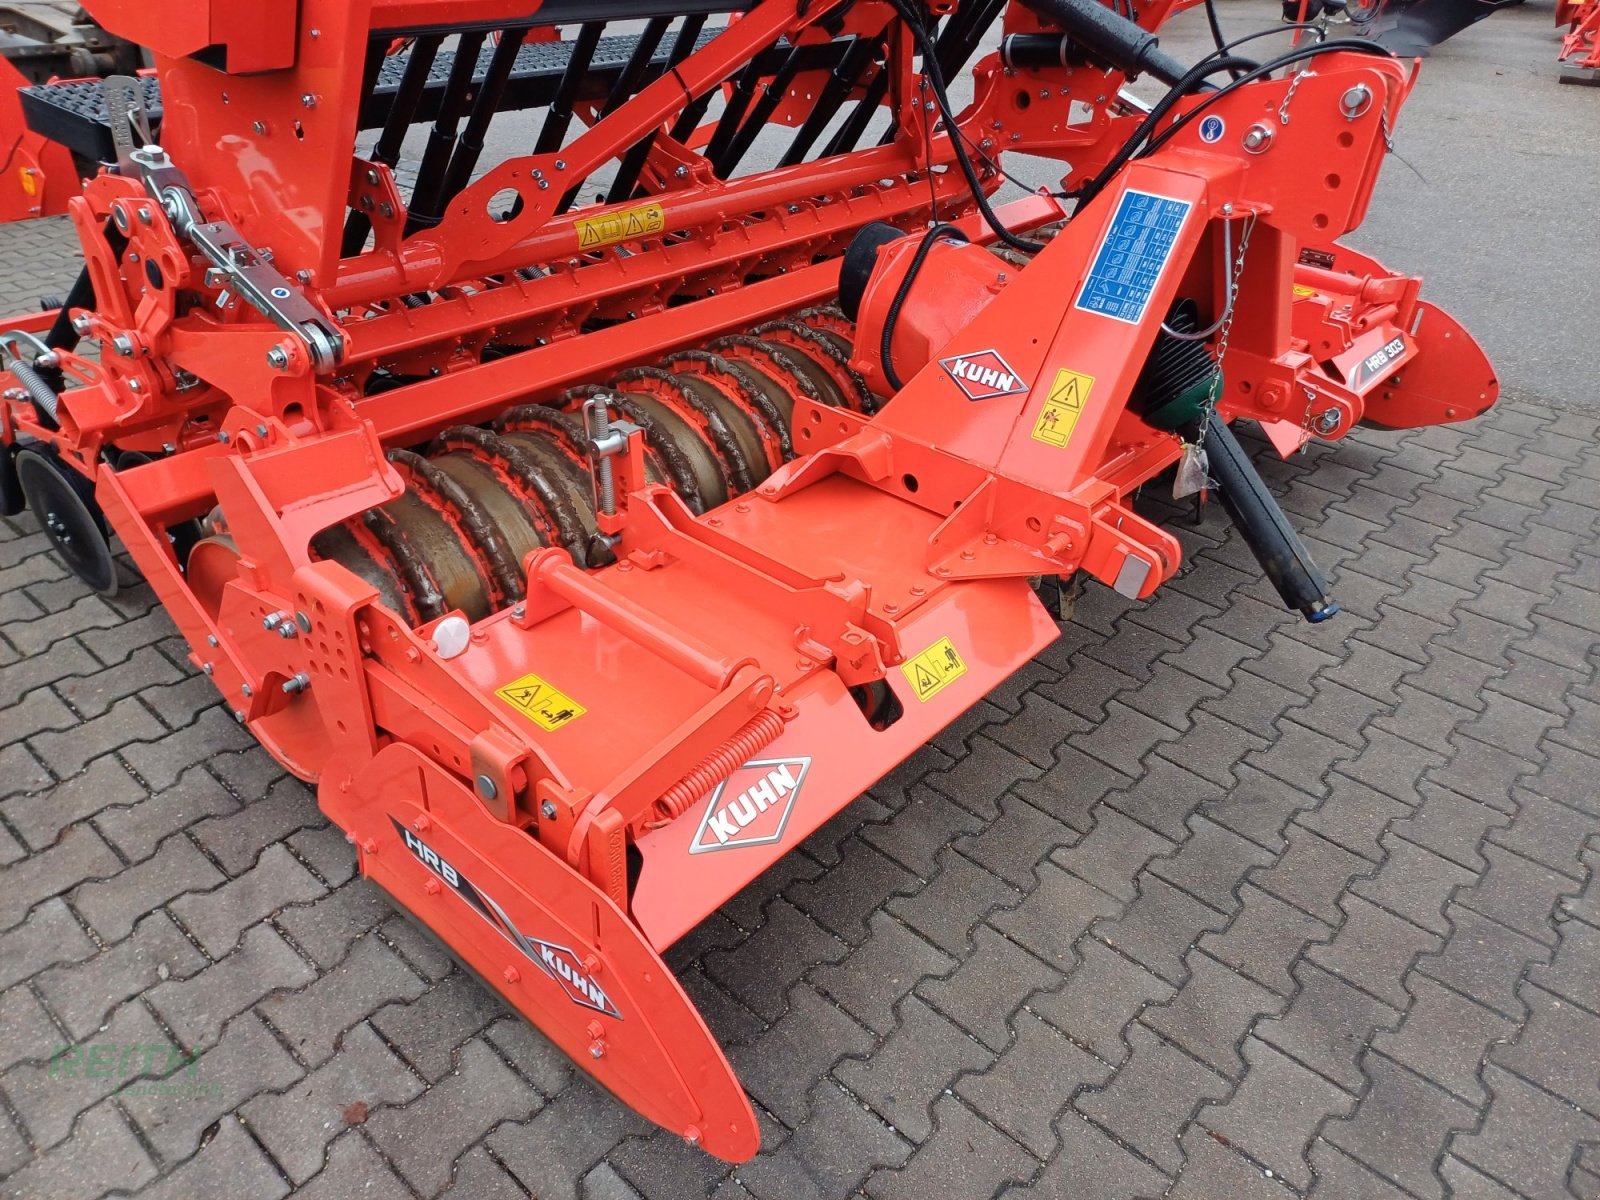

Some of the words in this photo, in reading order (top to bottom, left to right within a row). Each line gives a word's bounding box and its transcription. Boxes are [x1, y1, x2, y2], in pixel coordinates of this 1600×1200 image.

[952, 358, 1014, 392] KUHN
[1365, 349, 1388, 372] HRB
[1384, 338, 1404, 358] 303
[707, 763, 797, 844] KUHN
[404, 830, 459, 888] HRB
[540, 943, 606, 1010] KUHN
